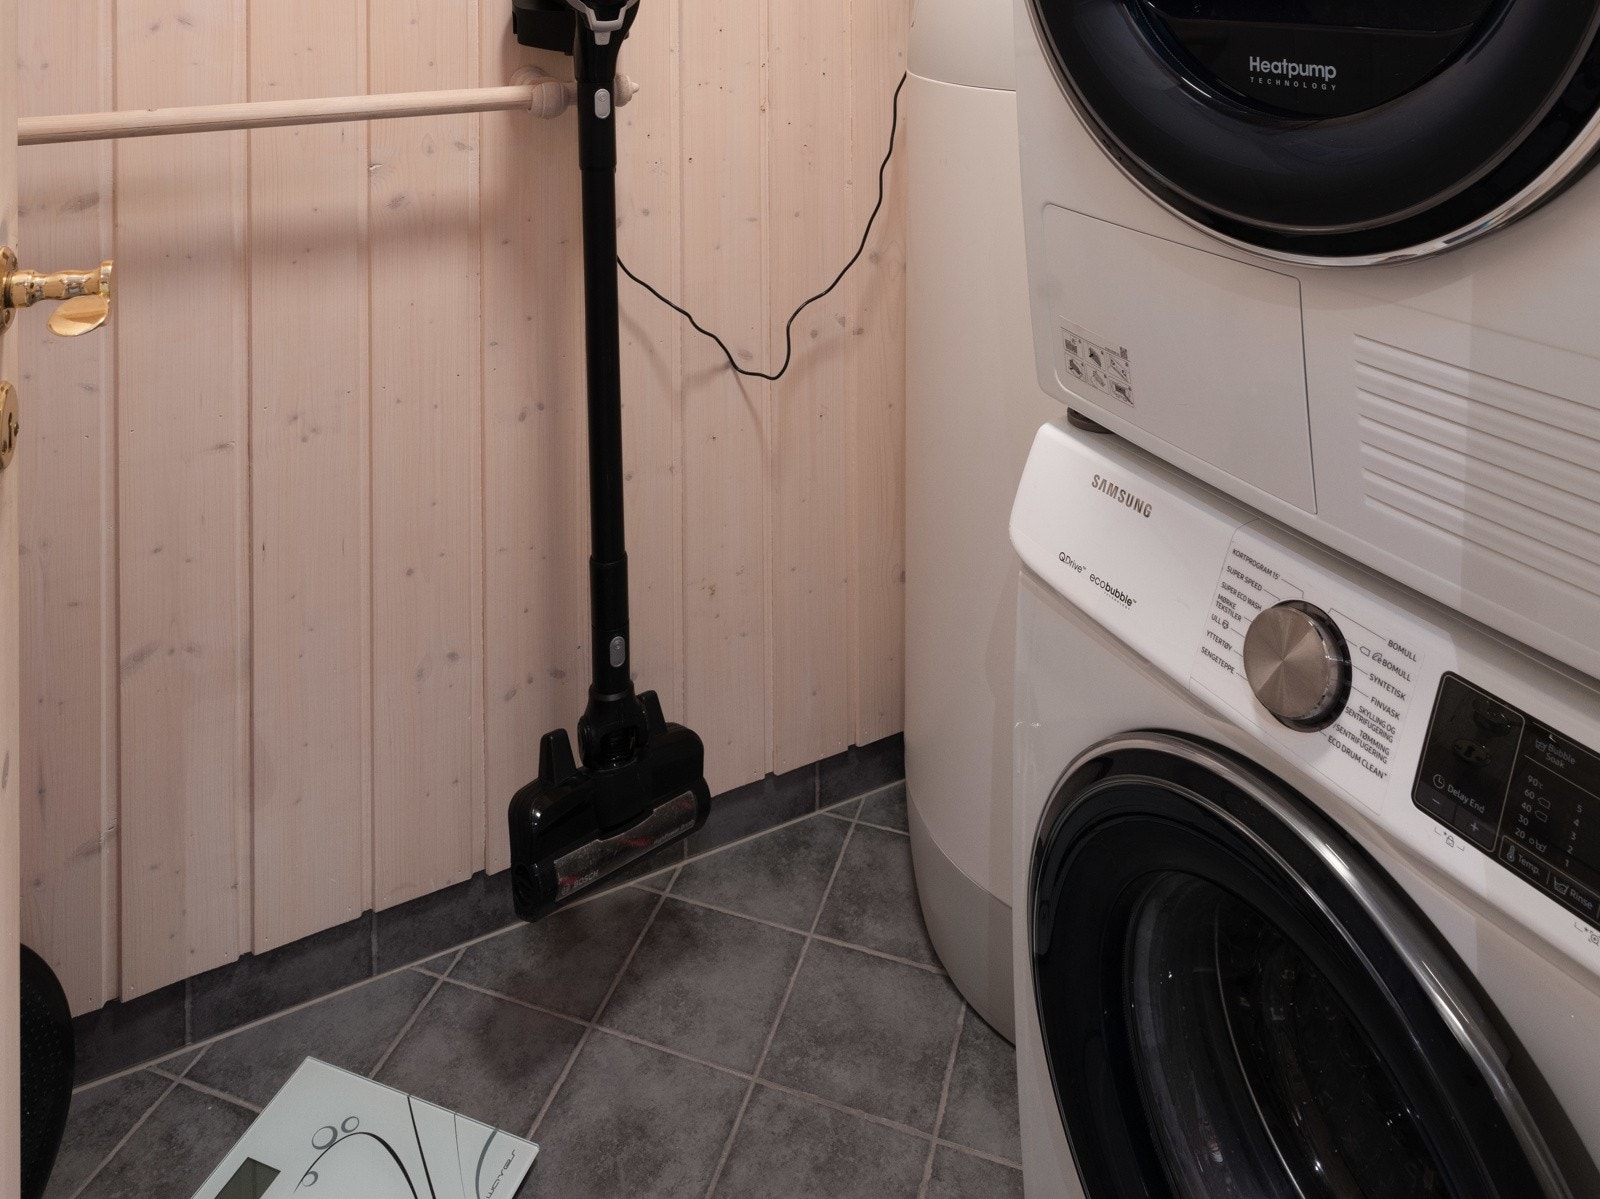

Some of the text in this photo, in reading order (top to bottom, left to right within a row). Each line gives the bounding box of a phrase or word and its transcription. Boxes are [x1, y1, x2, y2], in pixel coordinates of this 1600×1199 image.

[1249, 56, 1337, 82] Heatpump
[1250, 76, 1336, 91] TECHNOLOGY
[1091, 474, 1152, 518] SAMSUNG
[1232, 548, 1273, 577] KORTPROGRAM
[1226, 565, 1263, 592] SUPER SPEED
[1217, 593, 1237, 610] MØRKE
[1220, 581, 1262, 611] SUPER ECO WASH
[1211, 613, 1222, 626] ULL
[1215, 600, 1242, 622] TEKSTILER
[1206, 629, 1233, 652] YTTERTØY
[1388, 639, 1417, 663] BOMULL
[1201, 646, 1236, 675] SENGETEPPE
[1382, 659, 1411, 682] BOMULL
[1369, 672, 1406, 701] SYNTETISK
[1359, 705, 1396, 735] SKYLLING OG
[1370, 696, 1401, 721] FINVASK
[1345, 706, 1394, 743] SENTRIFUGERING
[1327, 735, 1341, 749] ECO
[1341, 745, 1361, 763] DRUM
[1360, 730, 1390, 756] TØMMING
[1547, 744, 1576, 765] Bubble
[1545, 752, 1565, 769] Soak
[1447, 784, 1485, 814] Delay End
[1524, 788, 1535, 800] 60
[1521, 802, 1532, 814] 40
[1518, 814, 1529, 826] 30
[1514, 827, 1526, 839] 20
[1518, 853, 1541, 876] Temp.
[1569, 888, 1594, 910] Rinse
